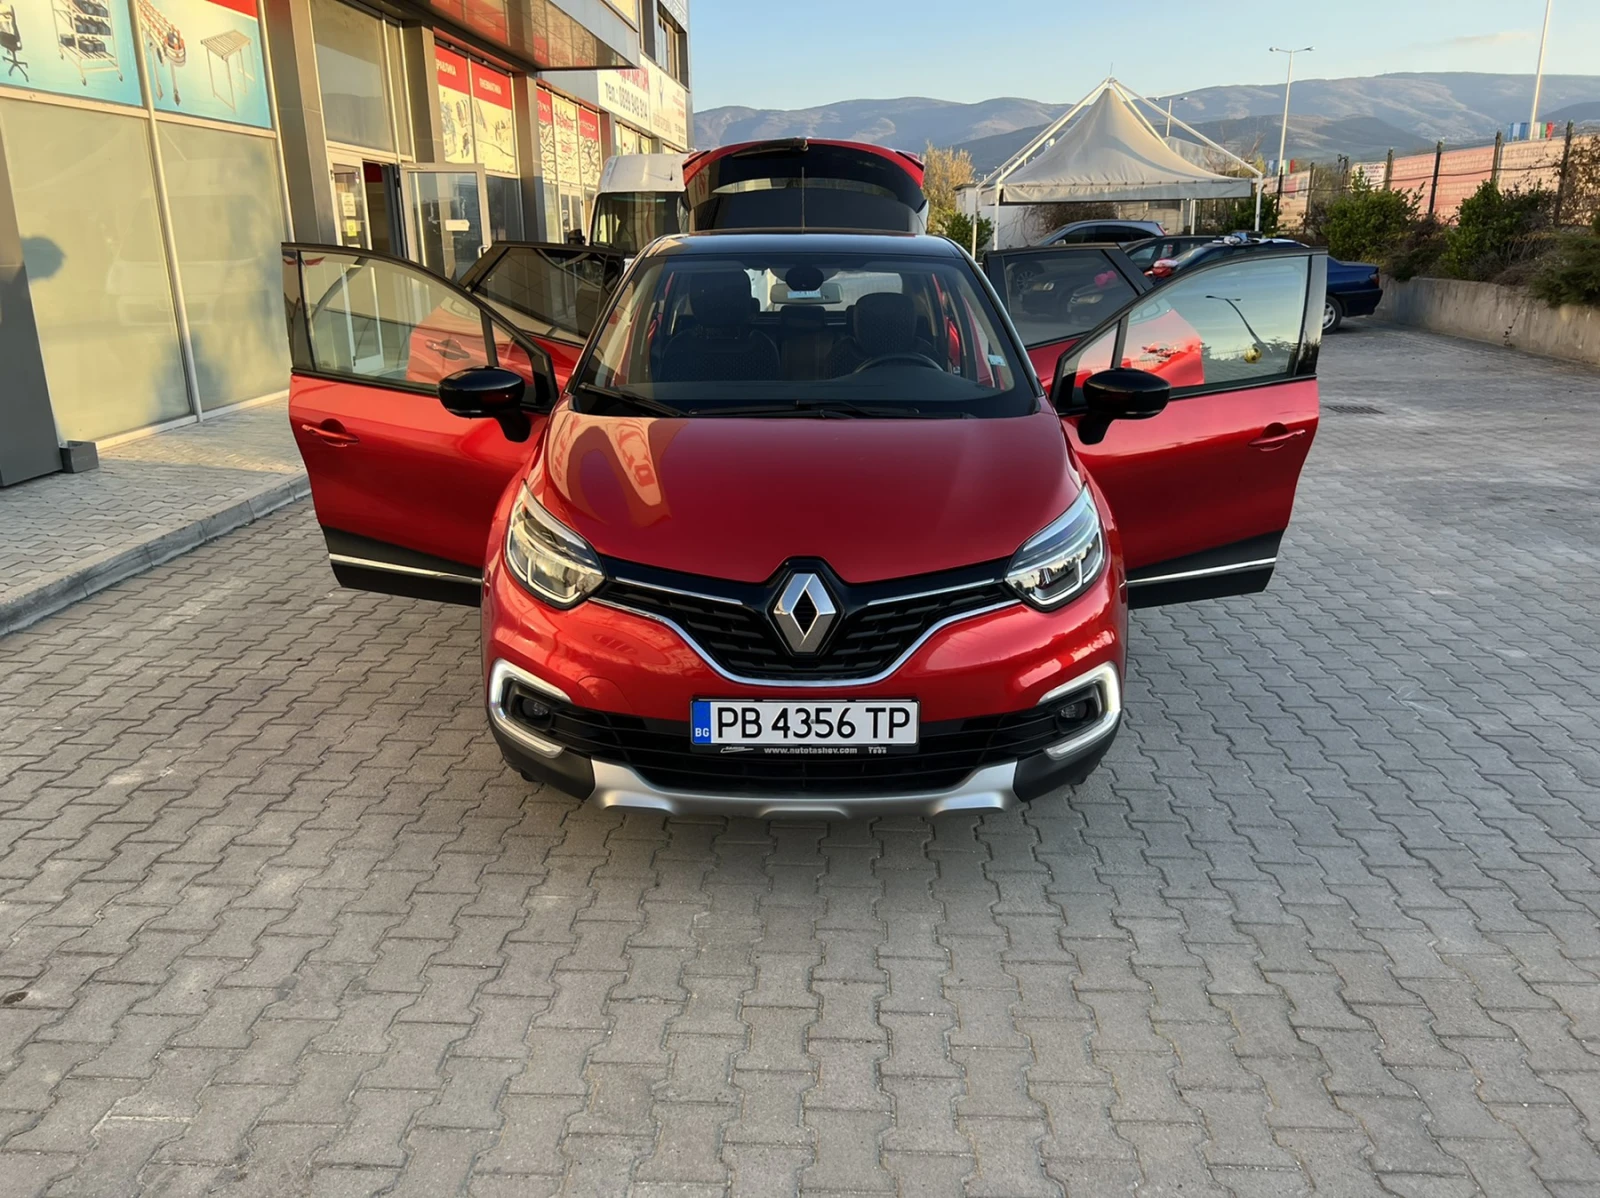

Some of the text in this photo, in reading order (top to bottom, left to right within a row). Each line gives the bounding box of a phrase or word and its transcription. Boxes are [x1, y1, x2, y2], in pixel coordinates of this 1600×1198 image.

[695, 728, 710, 737] BG
[717, 707, 911, 739] PB 4356 TP
